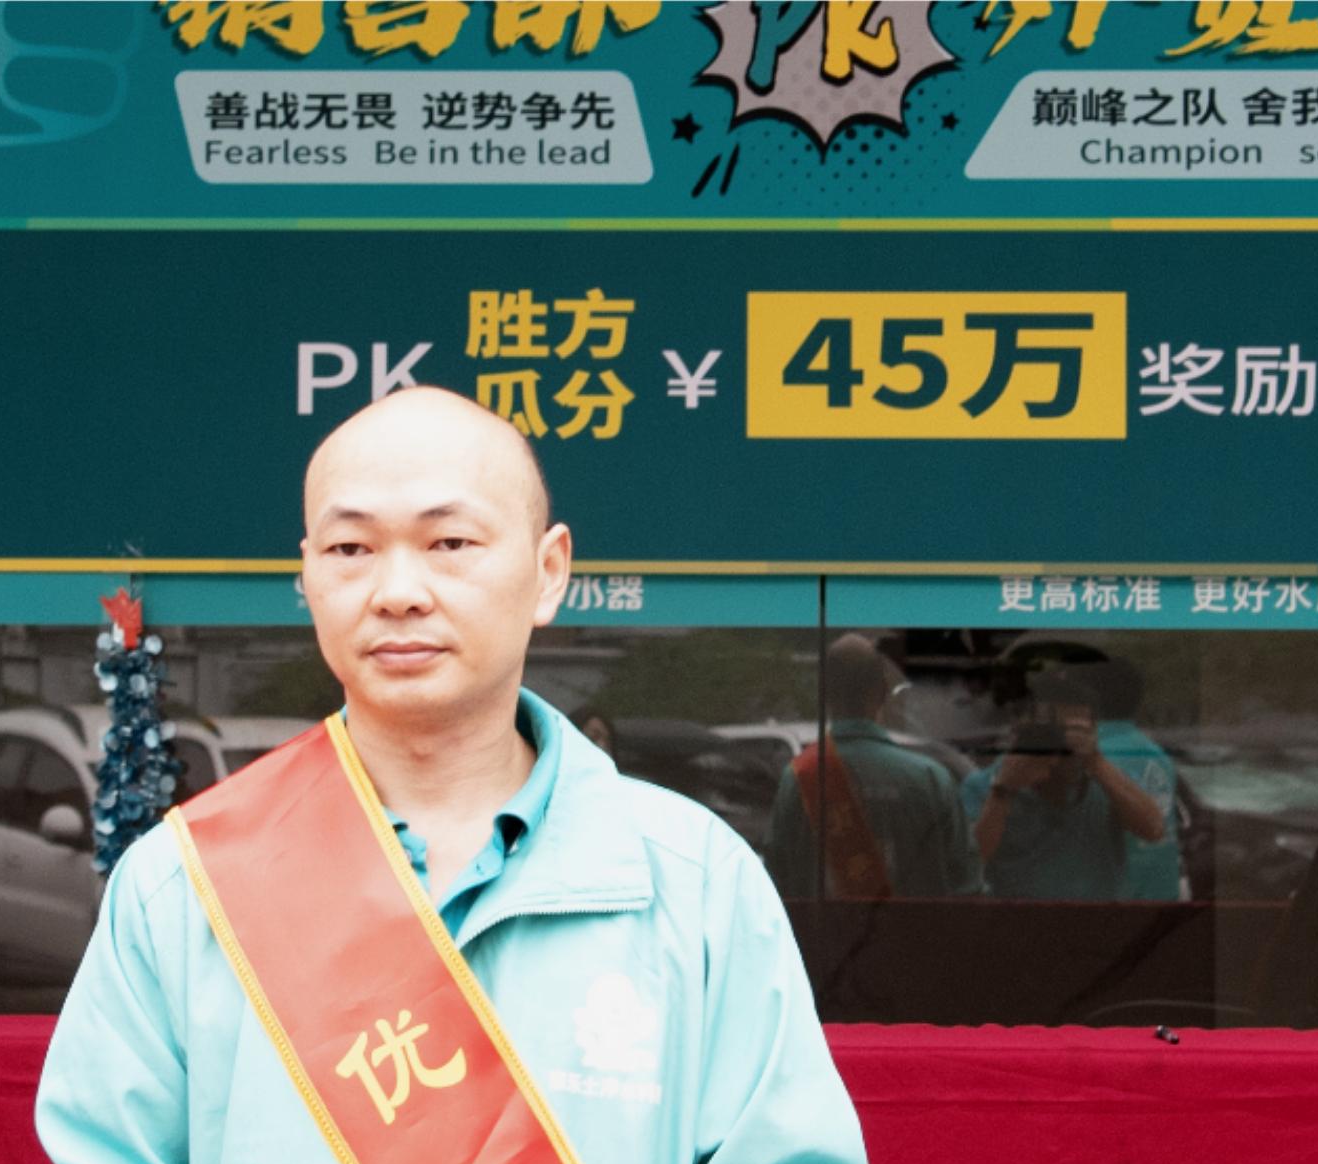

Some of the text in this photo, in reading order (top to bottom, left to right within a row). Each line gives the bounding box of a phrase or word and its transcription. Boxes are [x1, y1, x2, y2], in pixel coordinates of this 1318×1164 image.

[204, 91, 615, 131] 善战无畏 逆势争先
[1032, 87, 1227, 127] 巅峰之队
[204, 138, 611, 166] Fearless Be in the lead
[1080, 137, 1263, 173] Champion
[465, 289, 635, 359] 胜方
[296, 341, 434, 415] PK
[782, 312, 1094, 419] 45万
[1138, 343, 1317, 416] 奖励
[475, 369, 635, 440] 瓜分
[998, 576, 1162, 613] 更高标准
